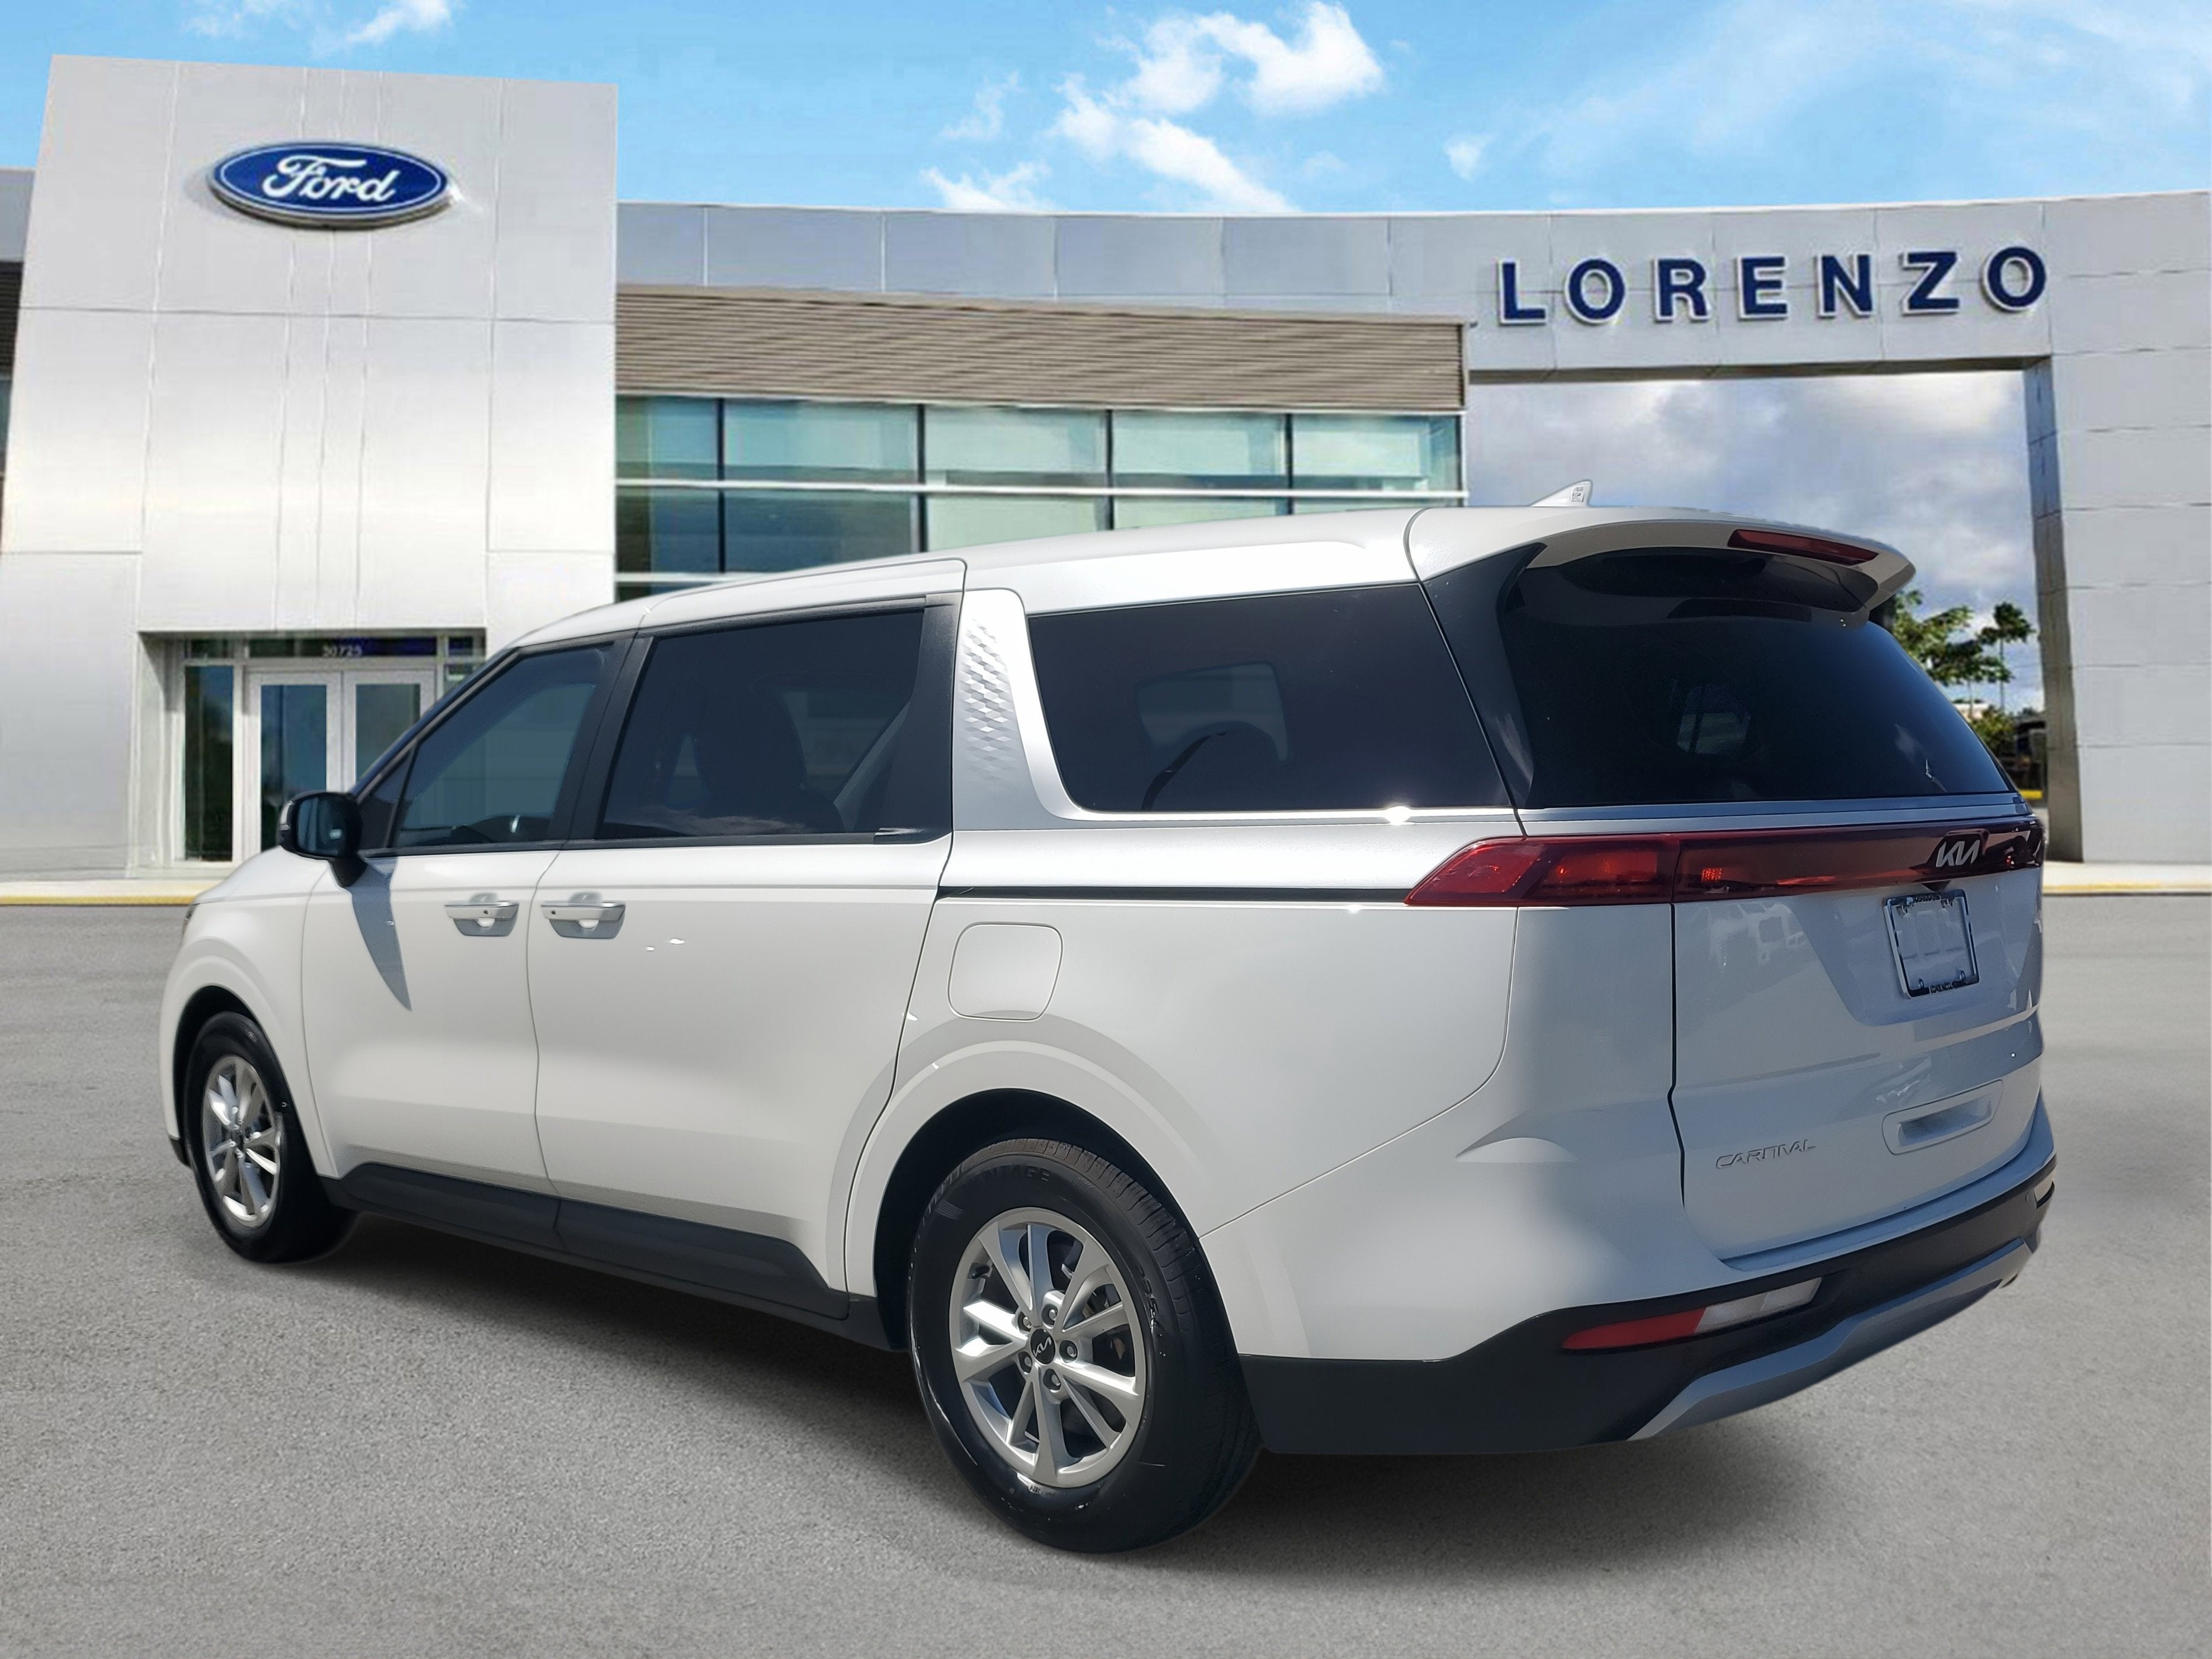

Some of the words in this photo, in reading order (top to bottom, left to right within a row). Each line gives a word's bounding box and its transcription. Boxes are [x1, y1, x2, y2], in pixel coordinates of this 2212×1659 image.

[262, 154, 401, 202] Ford
[1497, 245, 2047, 325] LORENZO
[1935, 840, 1980, 868] KIA
[1715, 1139, 1816, 1169] CARNIVAL
